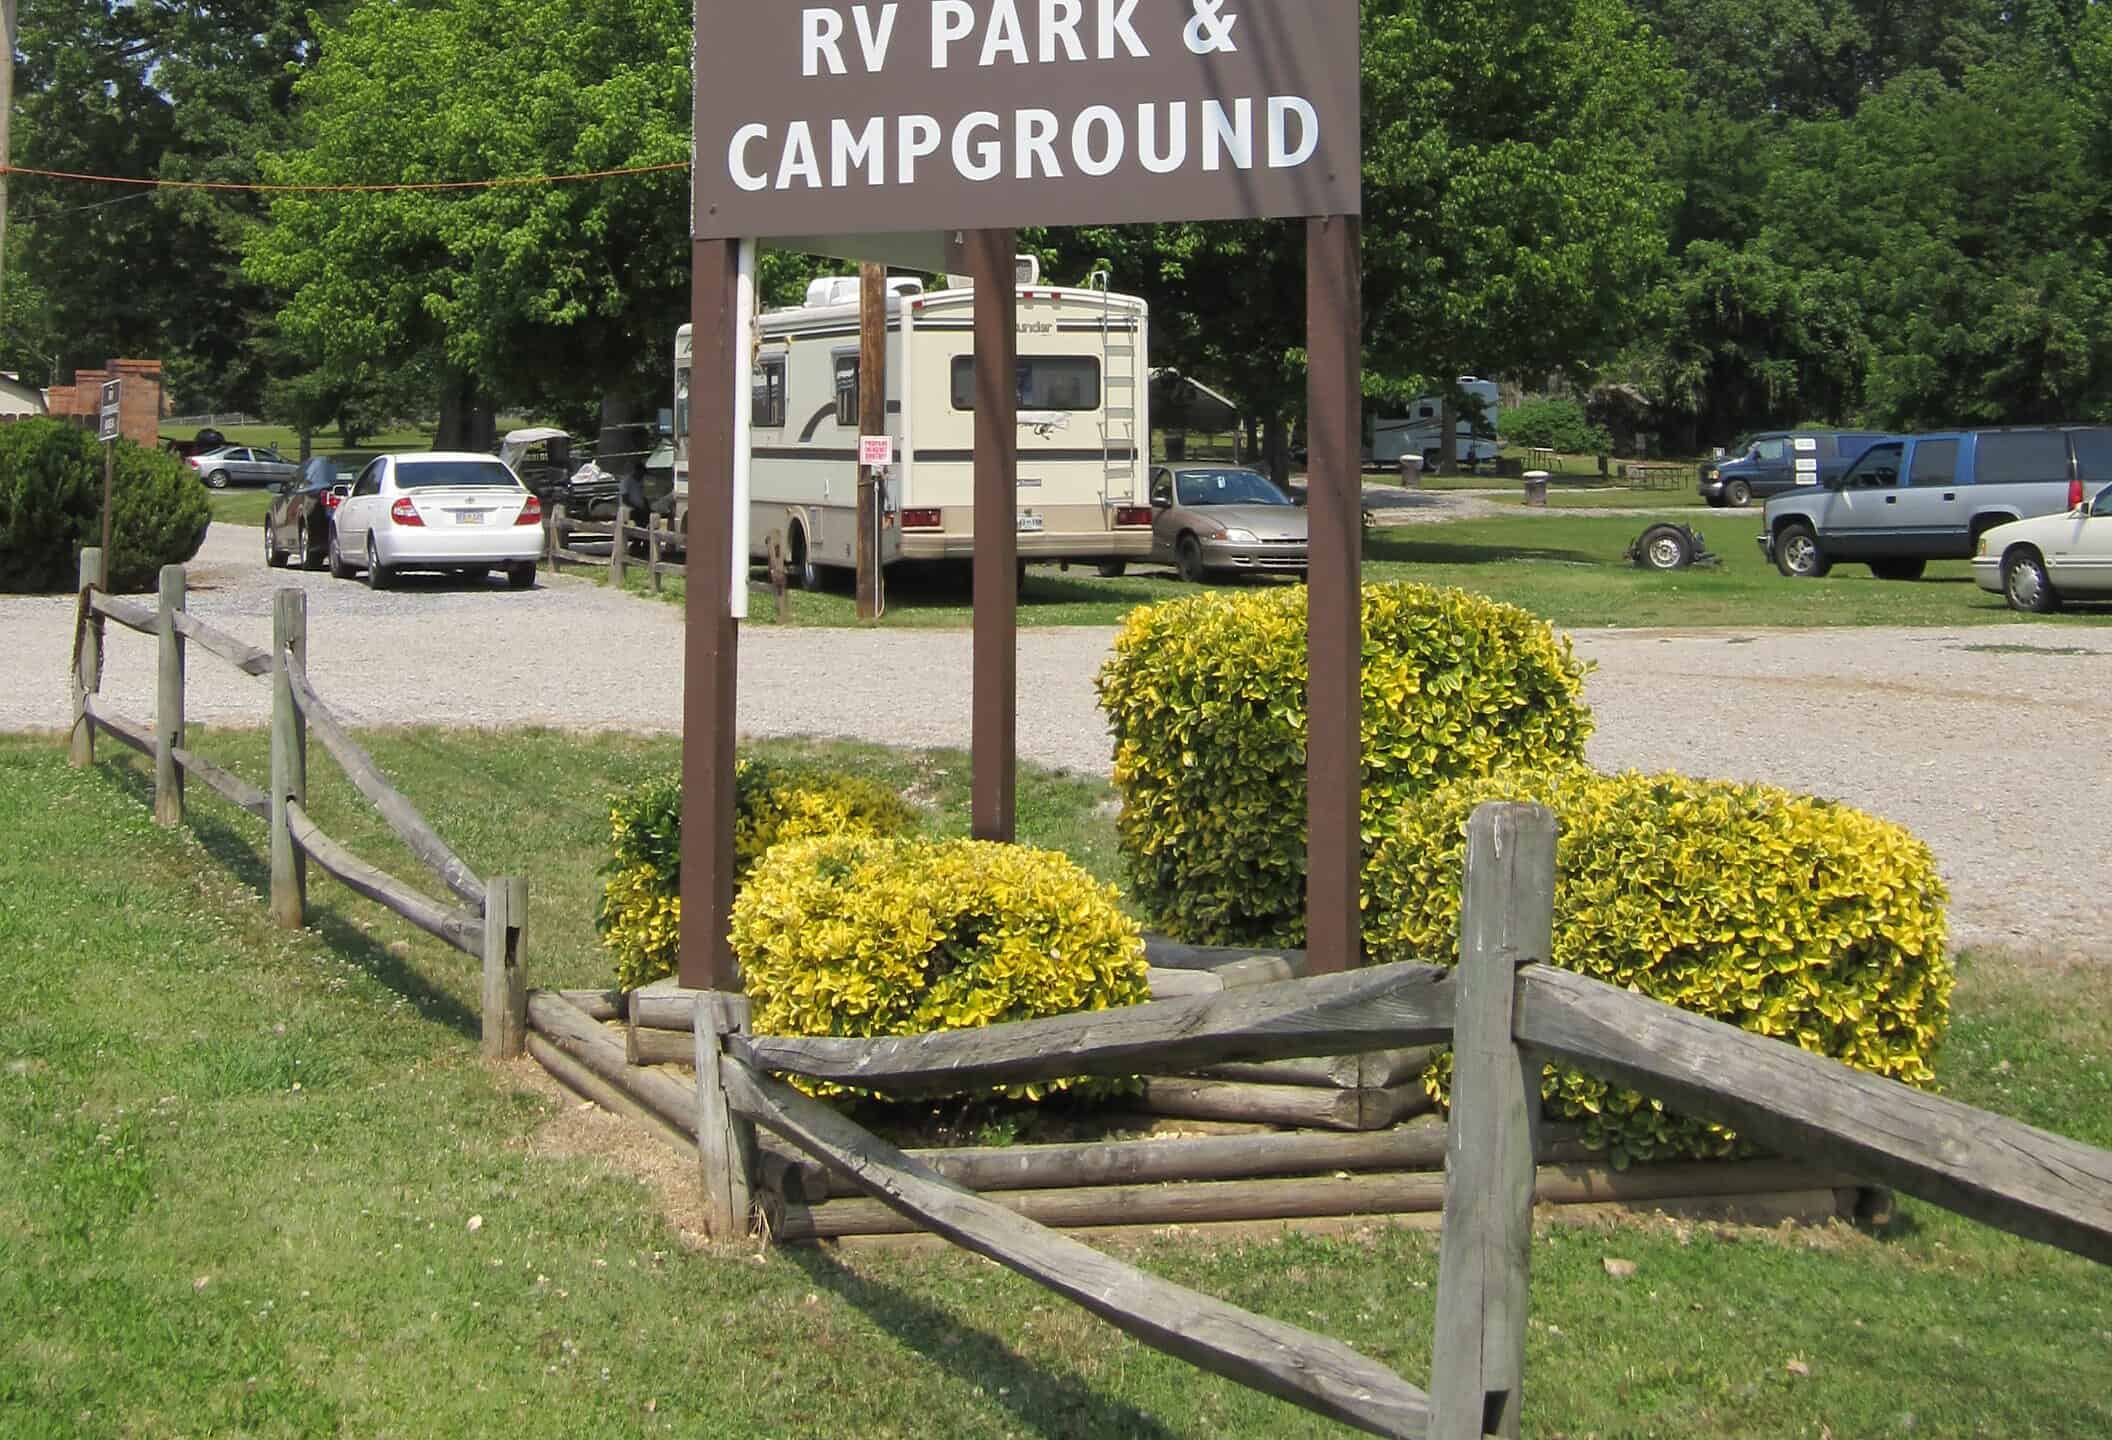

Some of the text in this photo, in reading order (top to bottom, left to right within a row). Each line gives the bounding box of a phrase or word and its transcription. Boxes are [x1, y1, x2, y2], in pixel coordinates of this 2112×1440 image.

[802, 0, 1238, 77] RV PARK &
[728, 95, 1319, 192] CAMPGROUND
[1016, 321, 1053, 333] under
